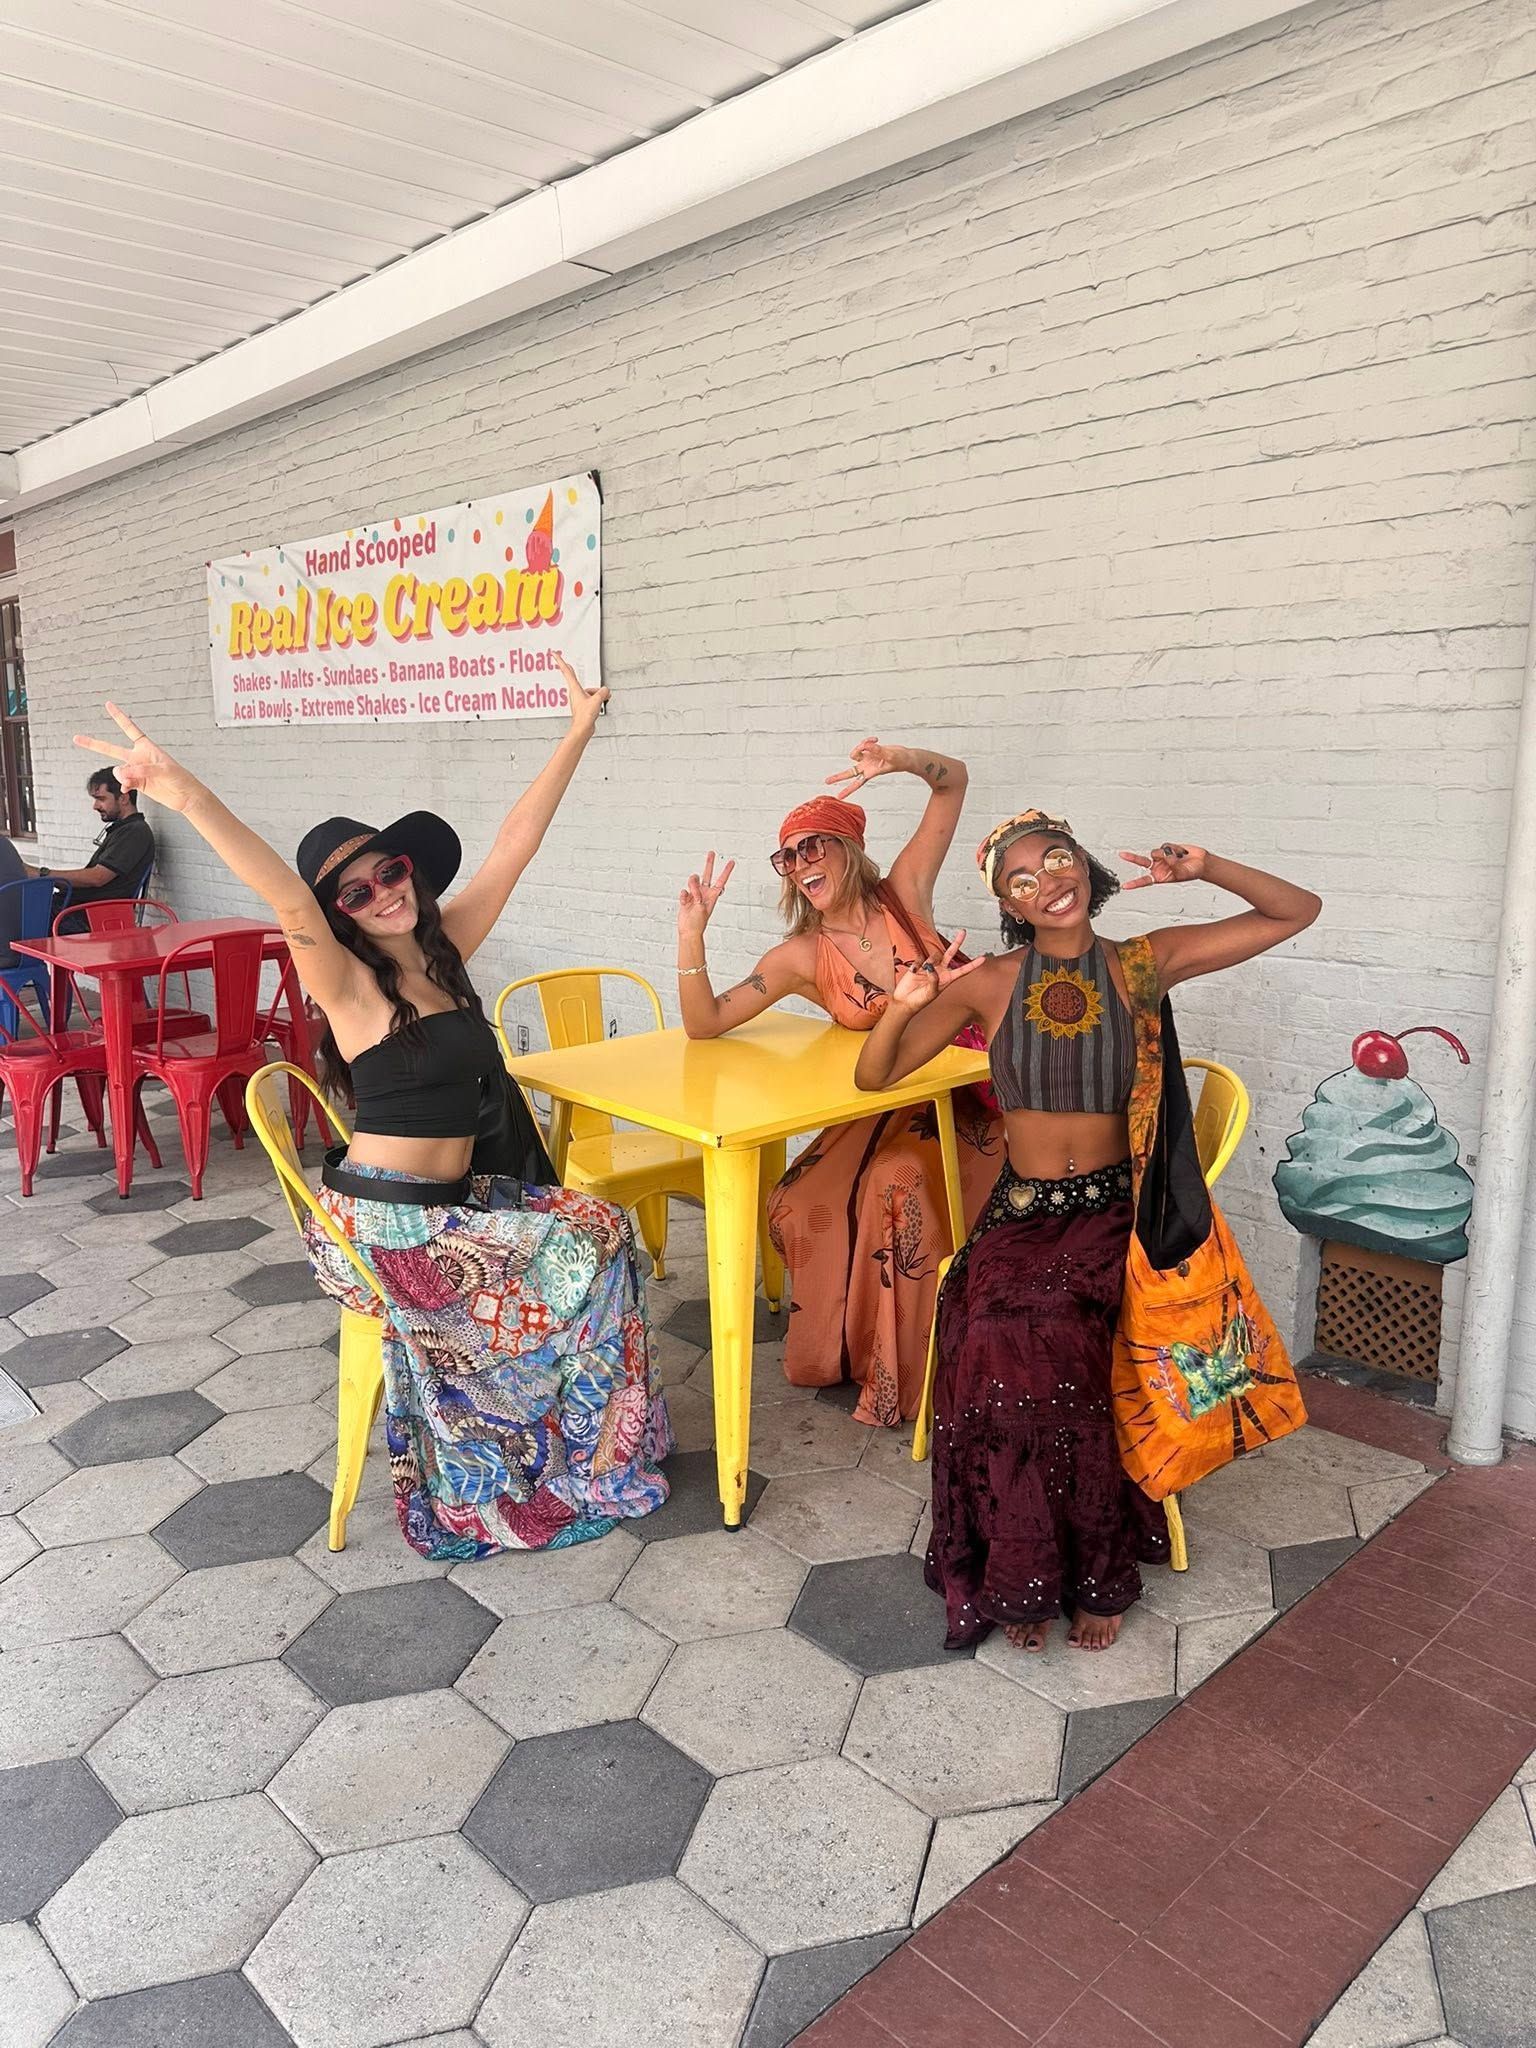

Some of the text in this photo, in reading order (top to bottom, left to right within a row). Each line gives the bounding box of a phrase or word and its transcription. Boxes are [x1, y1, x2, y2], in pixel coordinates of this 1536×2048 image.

[305, 522, 436, 577] Hand Scooped
[228, 567, 565, 660] Real Ice Cream
[233, 672, 271, 692] Shakes
[280, 668, 314, 689] Malts
[323, 664, 378, 686] Sundaes
[389, 659, 444, 682] Banana
[449, 654, 495, 678] Boats
[234, 700, 256, 720] Acai
[258, 698, 292, 718] Bowls
[301, 698, 354, 716] Extreme
[356, 693, 407, 716] Shakes
[419, 692, 440, 713] Ice
[445, 690, 497, 712] Cream
[502, 683, 568, 710] Nachos
